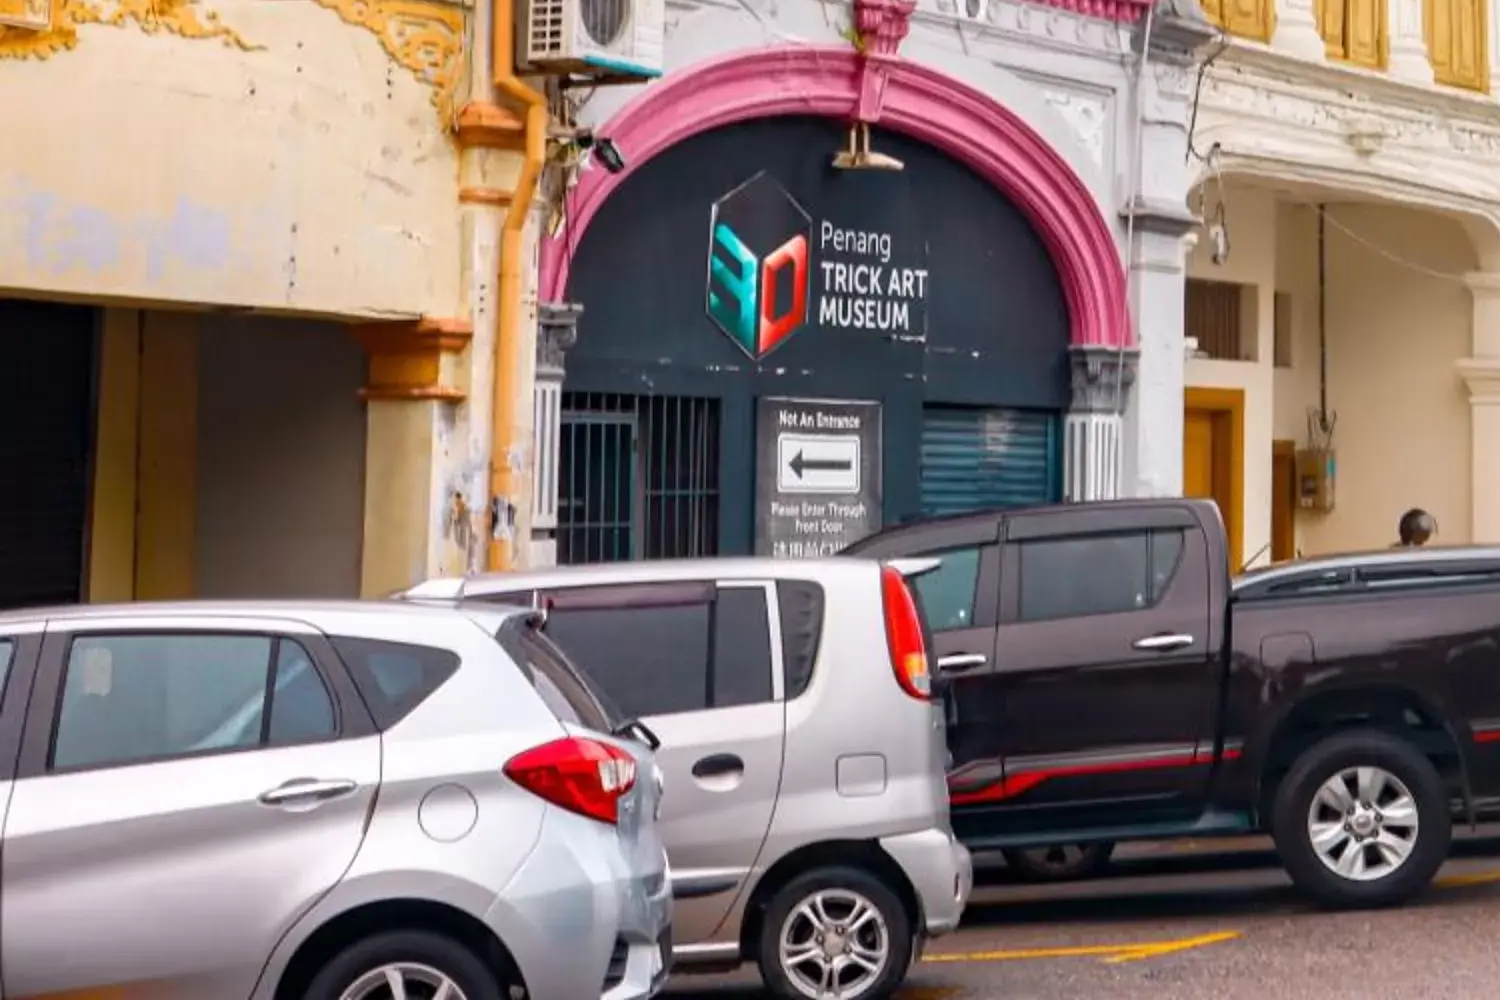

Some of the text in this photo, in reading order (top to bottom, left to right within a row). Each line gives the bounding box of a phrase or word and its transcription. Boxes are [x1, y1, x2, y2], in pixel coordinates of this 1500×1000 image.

[821, 220, 891, 262] Penang
[821, 261, 928, 299] TRICK ART
[819, 296, 909, 330] MUSEUM
[779, 409, 861, 429] Not An Entrance
